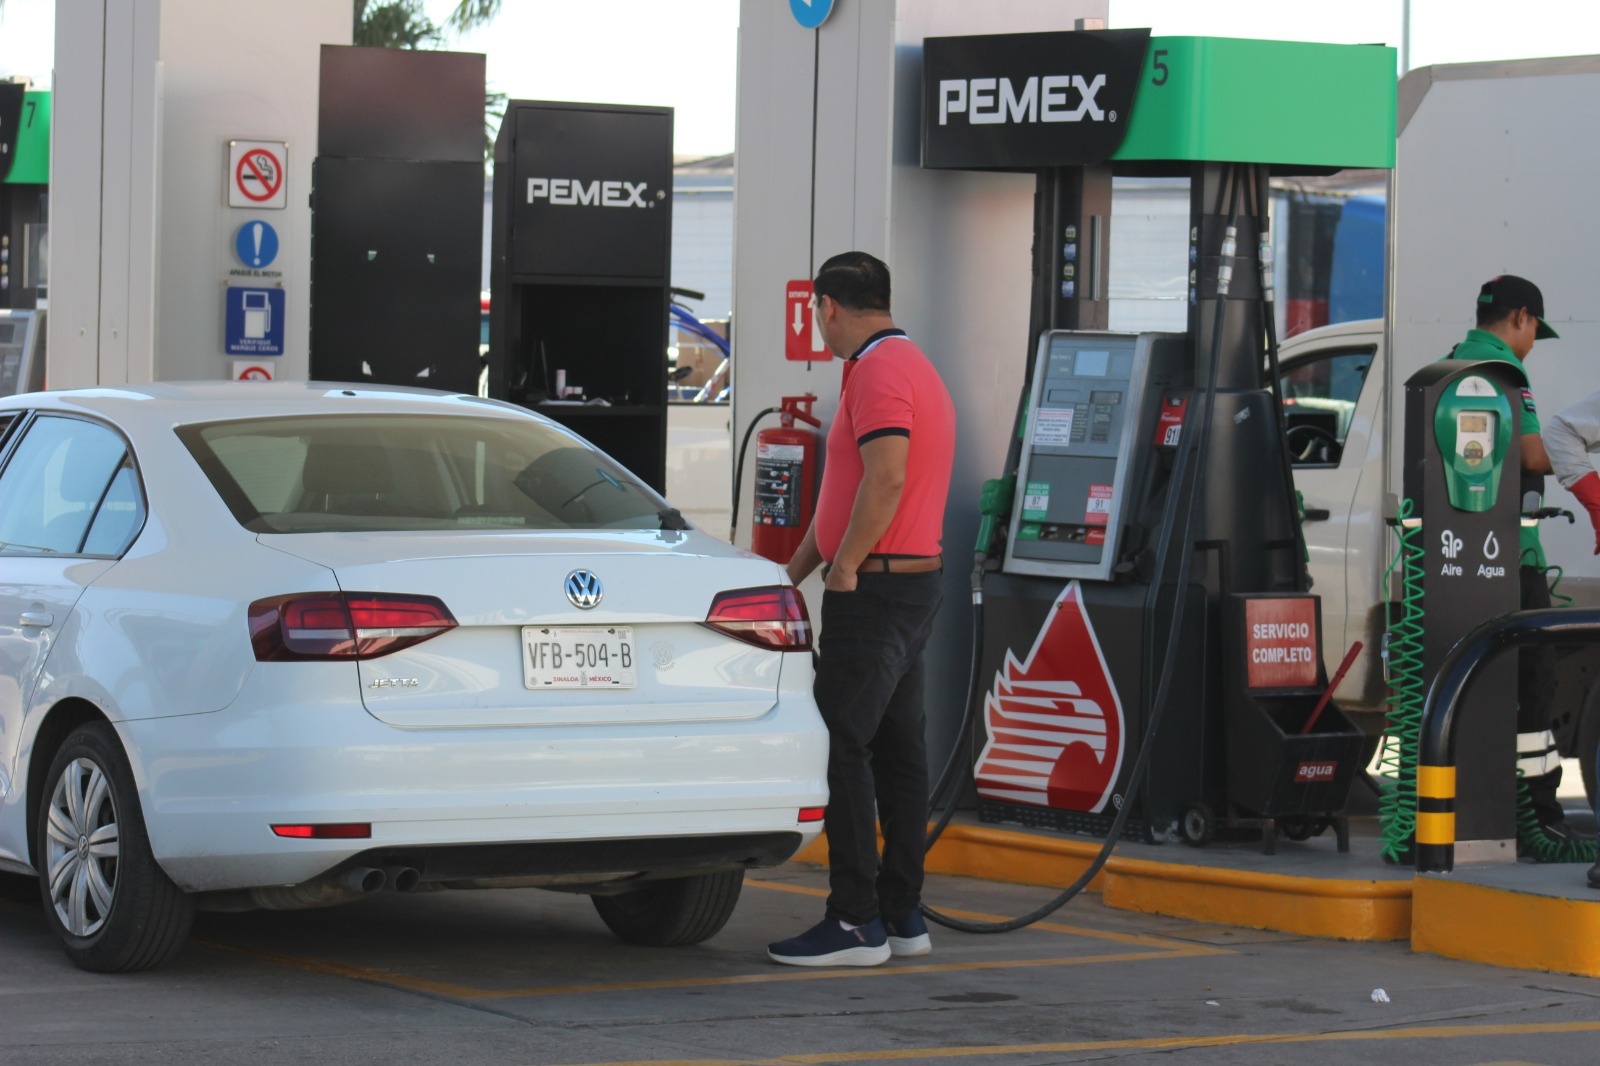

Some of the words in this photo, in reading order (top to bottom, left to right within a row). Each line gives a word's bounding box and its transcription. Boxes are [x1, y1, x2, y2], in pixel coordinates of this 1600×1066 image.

[1151, 49, 1169, 87] 5
[938, 73, 1107, 126] PEMEX
[26, 101, 37, 129] 7
[526, 177, 648, 208] PEMEX
[230, 269, 252, 277] APAGUE
[261, 270, 282, 278] MOTOR
[1031, 496, 1041, 506] 87
[1095, 499, 1104, 508] 91
[1441, 563, 1463, 576] Aire
[1477, 564, 1505, 579] Agua
[1252, 623, 1310, 640] SERVICIO
[527, 642, 632, 669] VFB-504-B
[1252, 646, 1313, 663] COMPLETO
[368, 677, 420, 689] JETTA
[1299, 765, 1333, 778] agua
